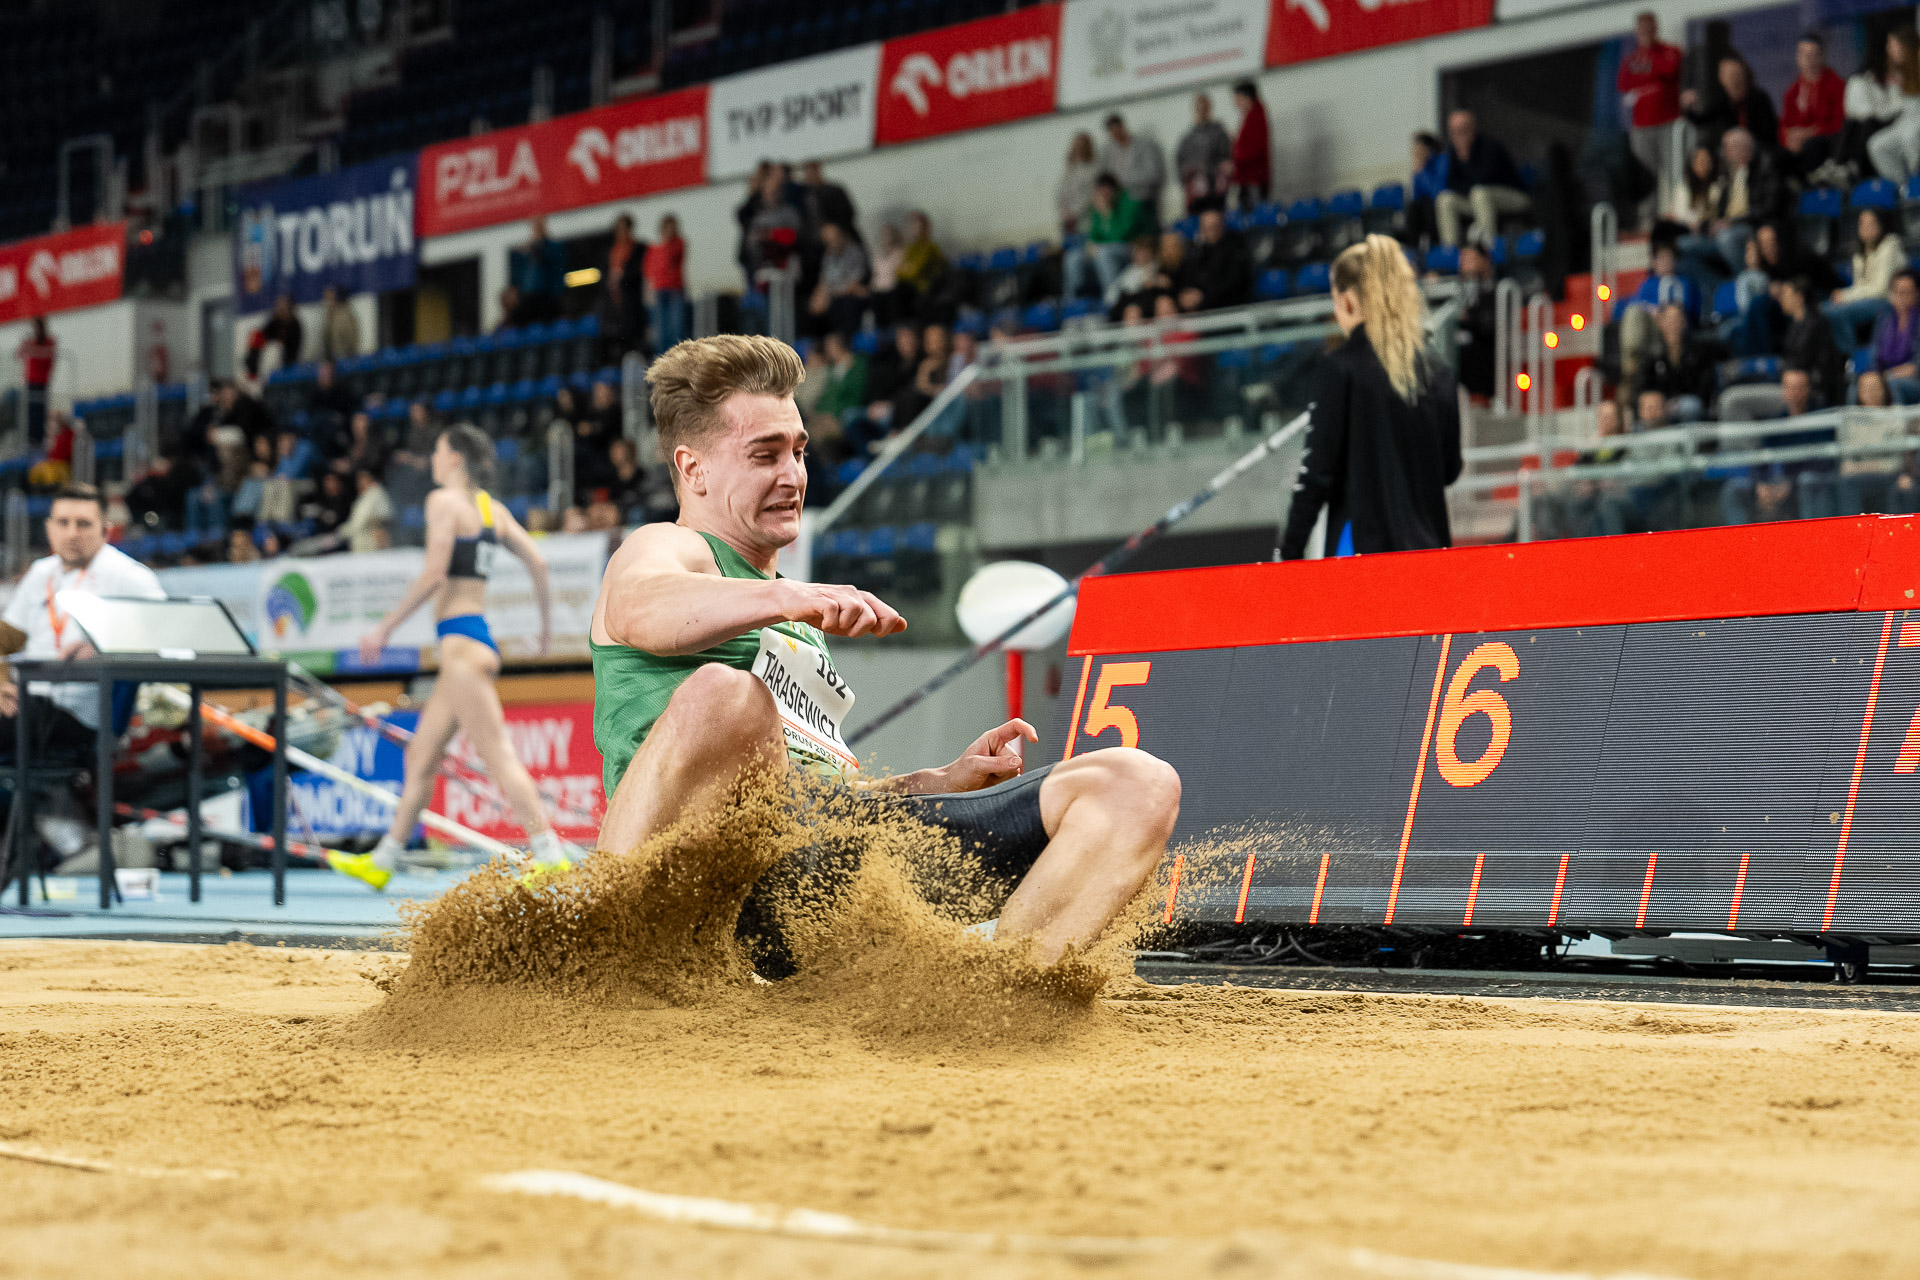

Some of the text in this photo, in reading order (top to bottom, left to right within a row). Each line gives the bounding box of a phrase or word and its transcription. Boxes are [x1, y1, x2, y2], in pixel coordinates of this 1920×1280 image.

[949, 37, 1052, 98] ORLEN
[614, 116, 700, 170] ORLEN
[726, 82, 863, 143] TVP SPORT
[436, 139, 541, 203] PZLA
[277, 167, 414, 276] TORUŃ
[762, 650, 841, 744] TARASIEWICZ
[816, 653, 846, 699] 182
[1083, 661, 1152, 750] 5
[783, 727, 813, 749] ORUN
[1435, 641, 1521, 787] 6
